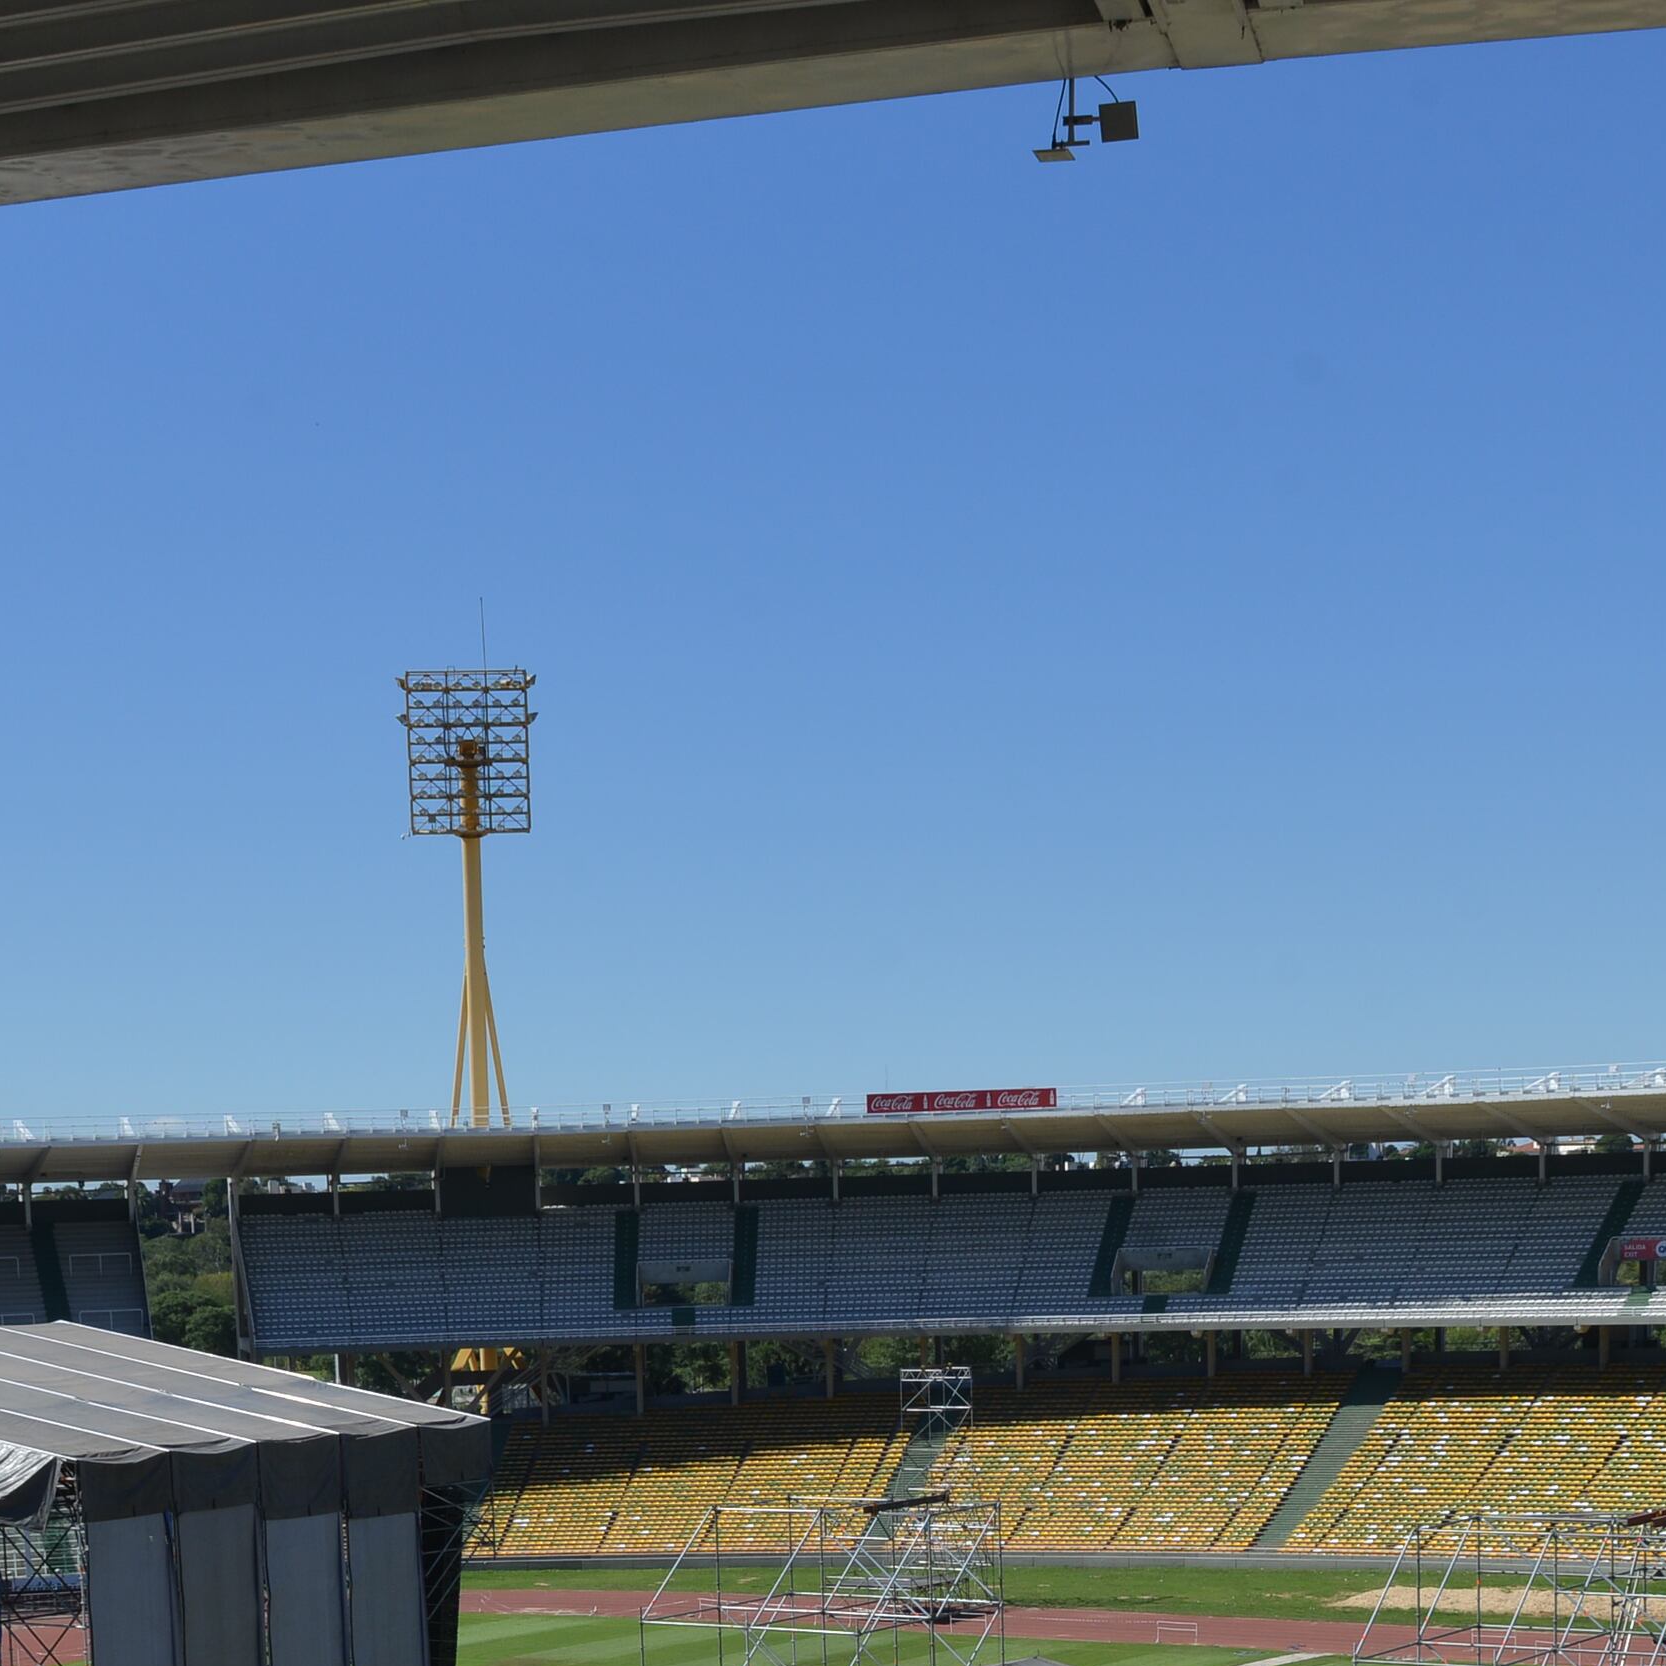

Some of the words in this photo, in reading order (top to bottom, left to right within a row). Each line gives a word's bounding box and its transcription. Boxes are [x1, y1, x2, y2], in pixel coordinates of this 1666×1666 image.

[871, 1095, 914, 1111] Coca-Cola
[934, 1093, 978, 1109] Coca-Cola
[997, 1090, 1041, 1106] Coca-Cola
